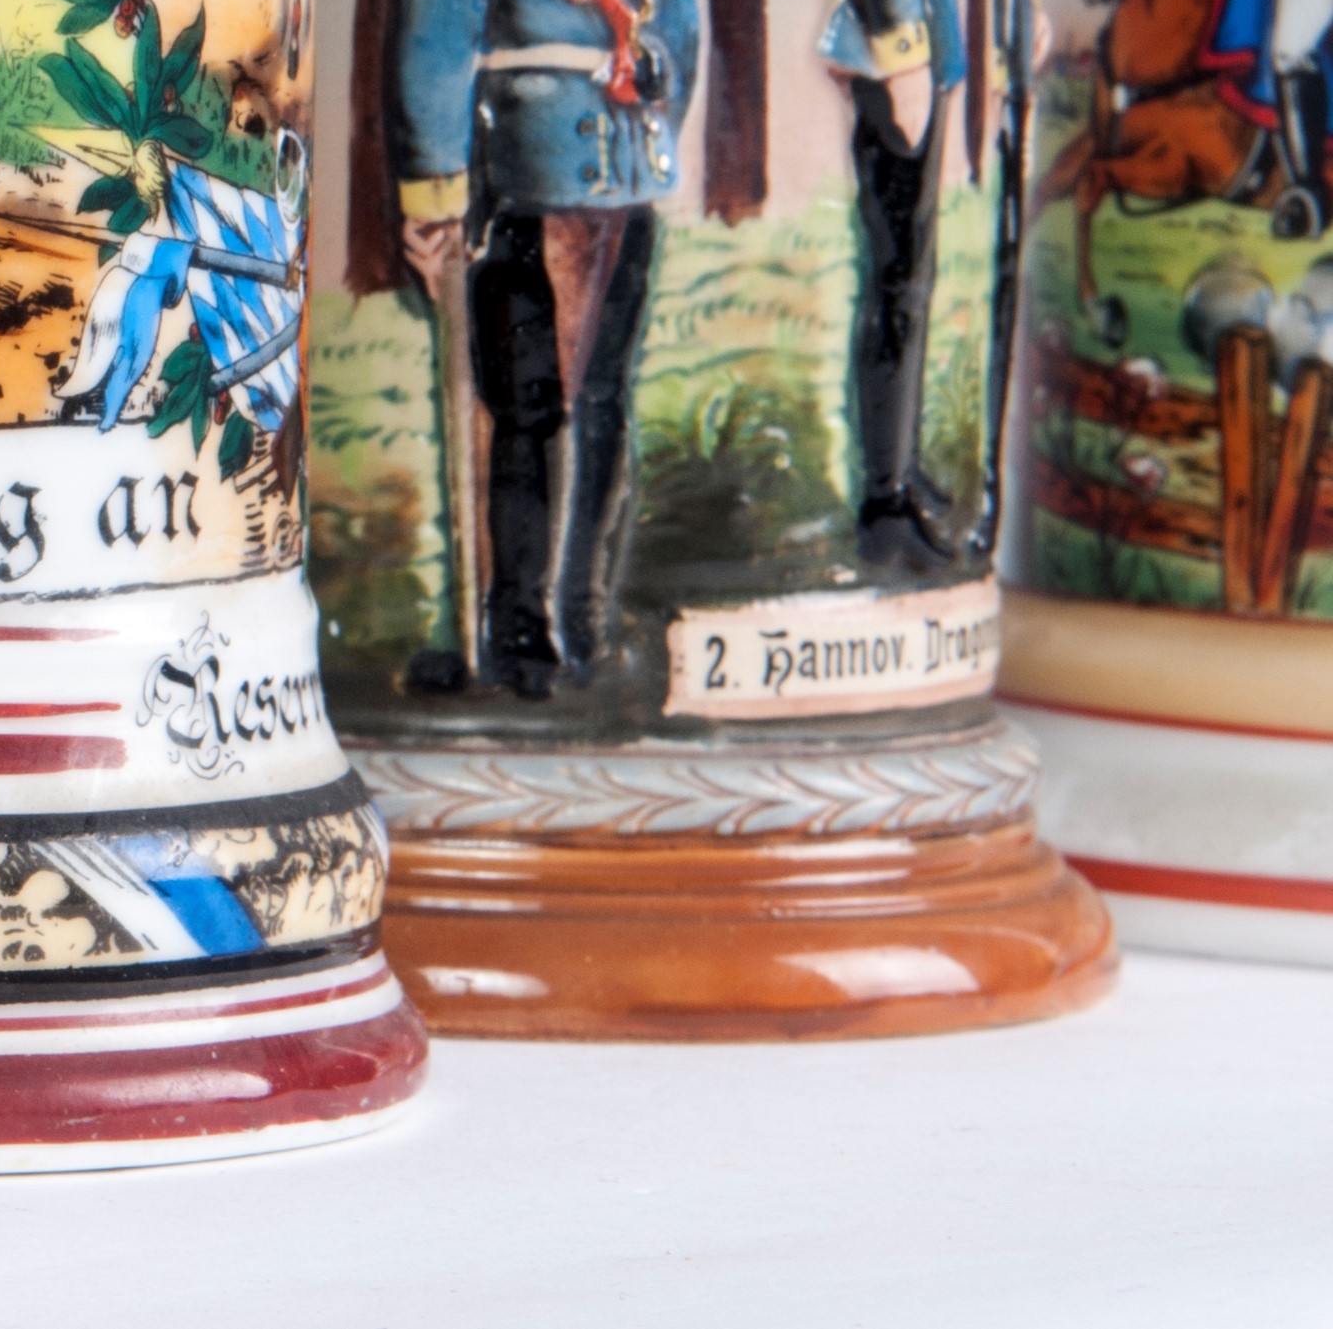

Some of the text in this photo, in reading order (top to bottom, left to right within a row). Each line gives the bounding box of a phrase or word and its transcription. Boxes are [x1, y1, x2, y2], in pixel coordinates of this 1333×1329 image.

[96, 469, 203, 551] an
[704, 635, 742, 689] 2.
[758, 629, 914, 697] Hannov.
